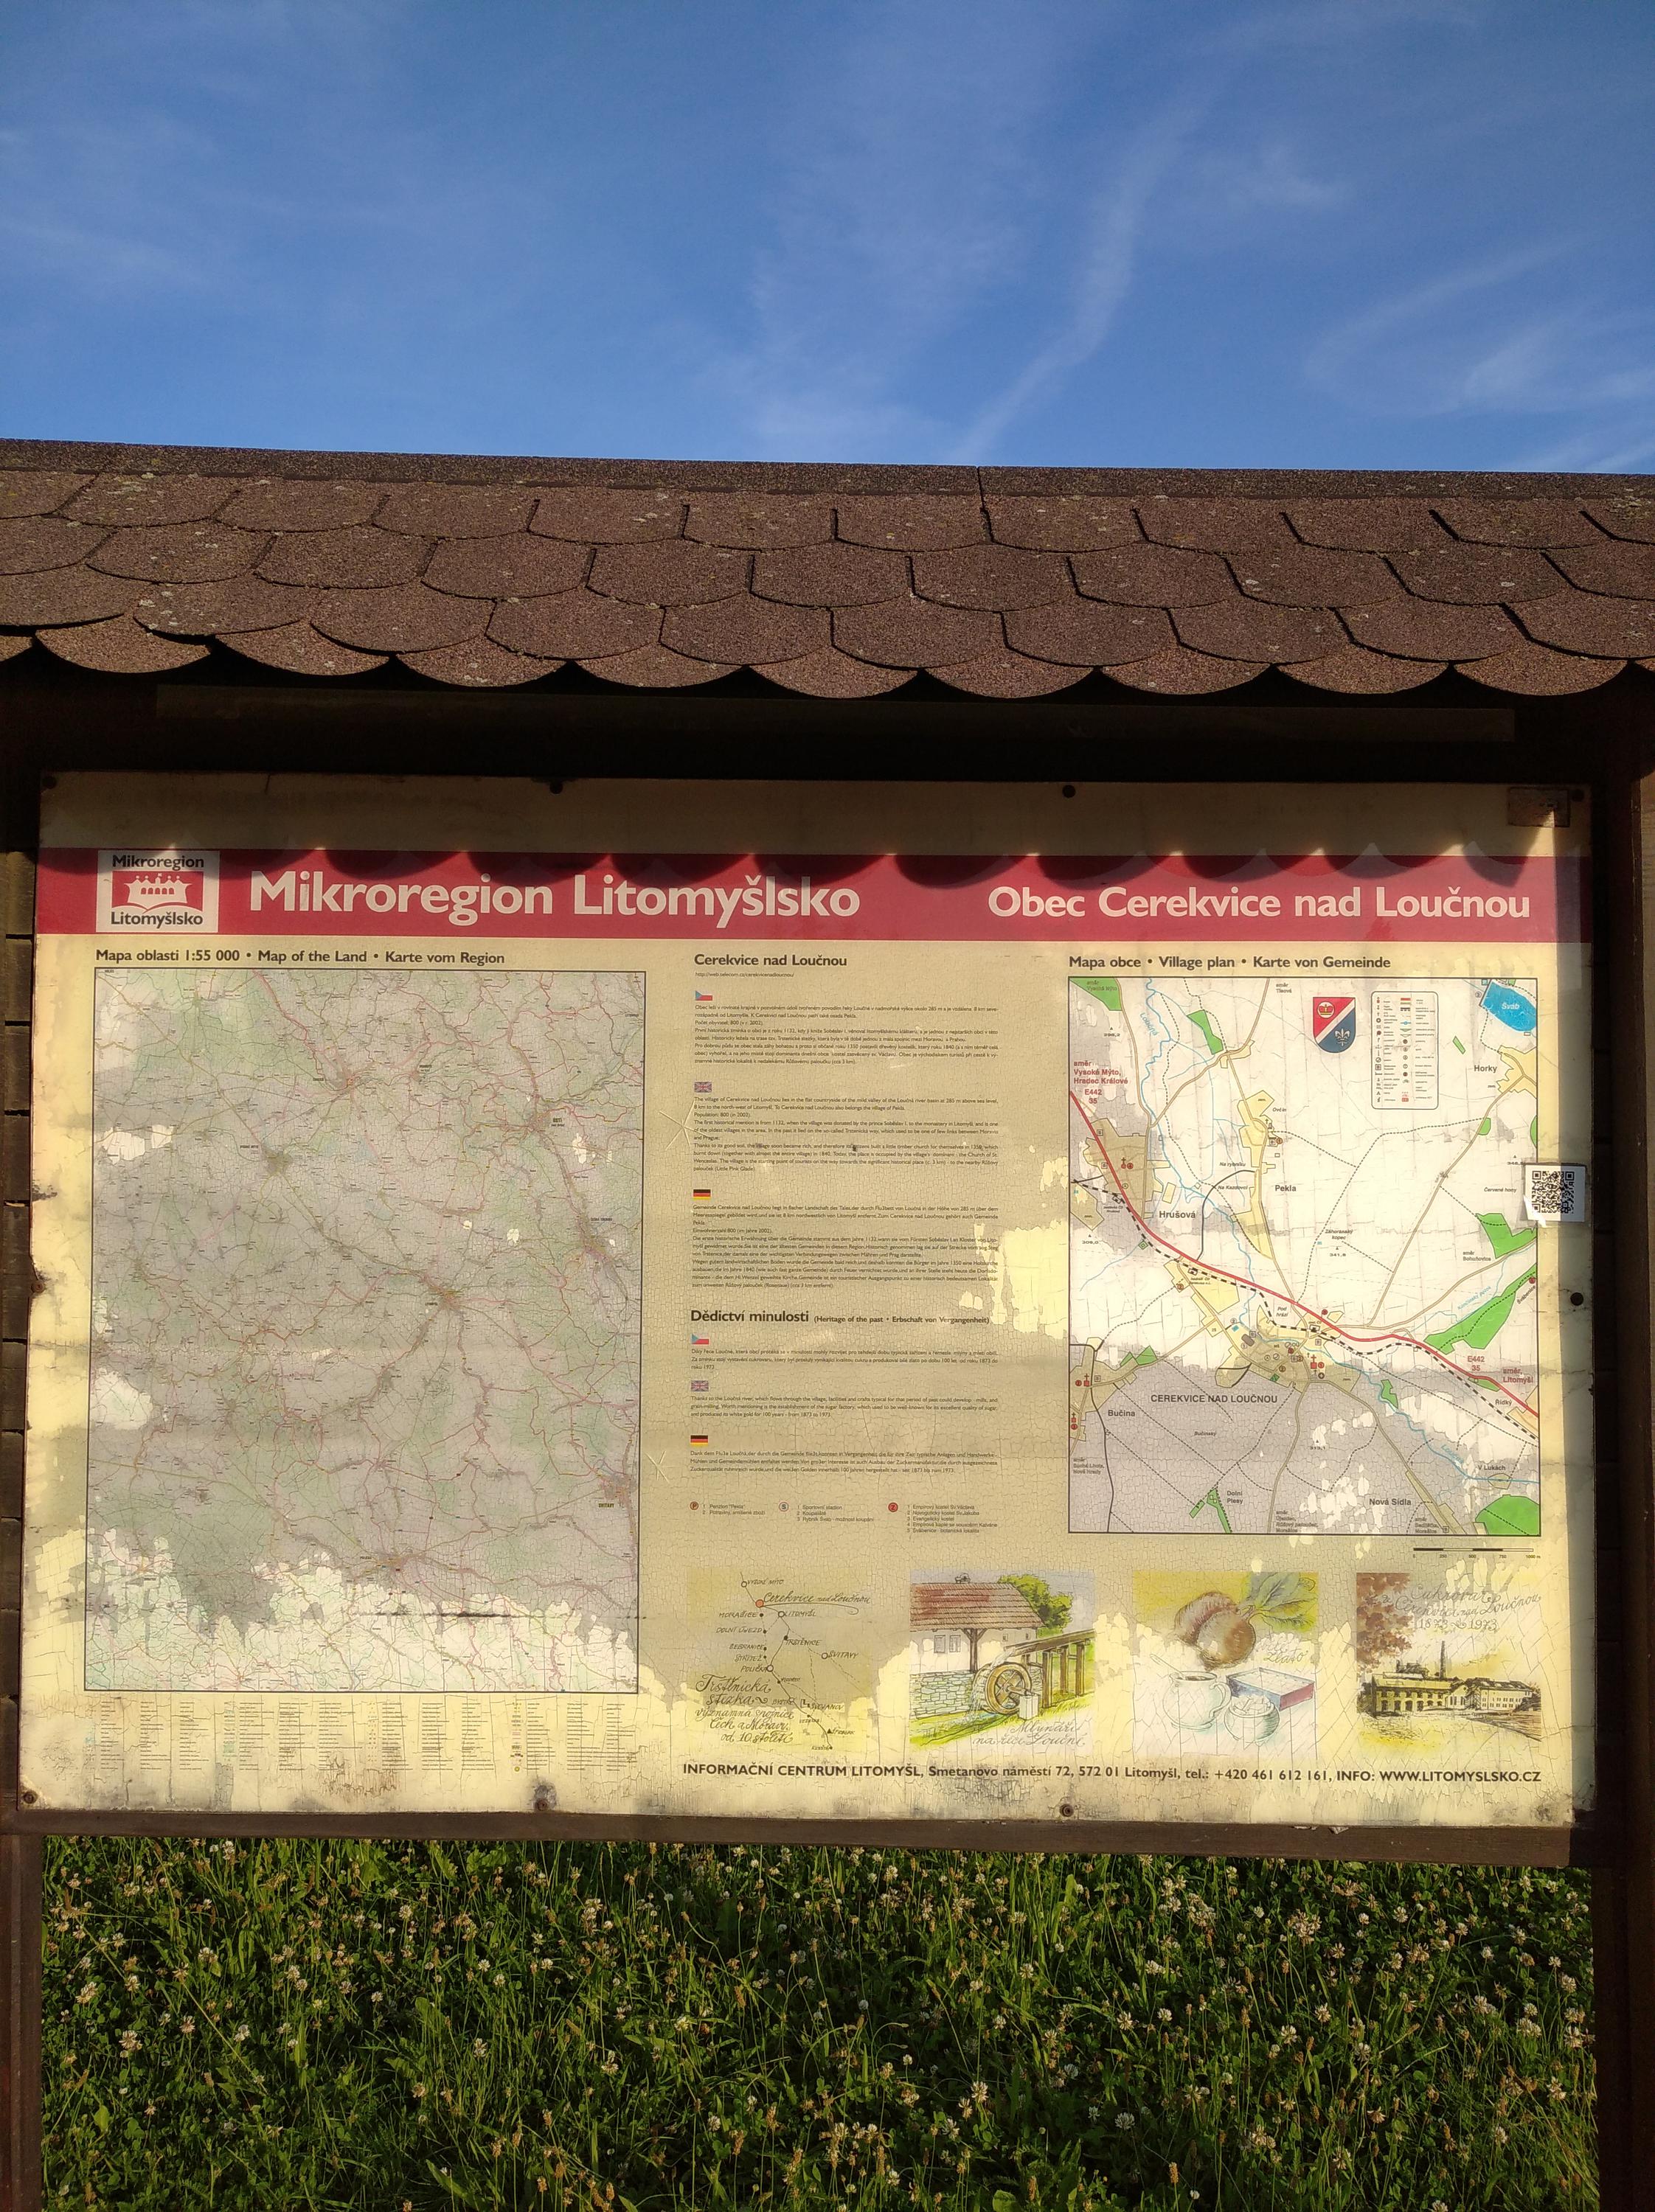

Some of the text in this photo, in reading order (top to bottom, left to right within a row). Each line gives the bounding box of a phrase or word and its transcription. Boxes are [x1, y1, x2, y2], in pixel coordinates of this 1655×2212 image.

[112, 855, 204, 870] Mikroregion
[250, 870, 860, 928] Mikroregion Litomyšlsko
[988, 886, 1530, 919] Obec Cerekvice nad Loučnou
[111, 911, 204, 928] Litomyšlsko
[96, 950, 504, 967] Mapa oblasti 1:55 000 Map of the Land Karte vom Region
[694, 953, 847, 966] Cerekvice nad Loučnou
[1069, 956, 1105, 970] Mapa
[1109, 956, 1142, 967] obce
[1159, 956, 1202, 971] Village
[1207, 956, 1235, 971] plan
[1253, 956, 1290, 967] Karte
[1322, 956, 1389, 968] Gemeinde
[1502, 1002, 1520, 1010] Šváb
[1101, 1068, 1121, 1077] Mýto,
[1474, 1065, 1497, 1073] Horky
[1275, 1184, 1297, 1192] Pekla
[1159, 1210, 1196, 1220] Hrušová
[690, 1310, 808, 1322] Dědictví minulosti
[813, 1314, 846, 1324] (Heritage
[869, 1315, 884, 1324] past
[892, 1315, 922, 1323] Erbschaft
[939, 1315, 989, 1326] Vergangenheit)
[1151, 1393, 1277, 1403] CEREKVICE NAD LOUČNOU
[1392, 1498, 1412, 1506] Sídla
[683, 1763, 1541, 1783] INFORMAČNÍ CENTRUM LITOMYŠL, Smetanovo náměstí 72, 572 01 Litomyšl, tel.: +420 461 612 161, INFO: WWW.LITOMYSLSKO.CZ
